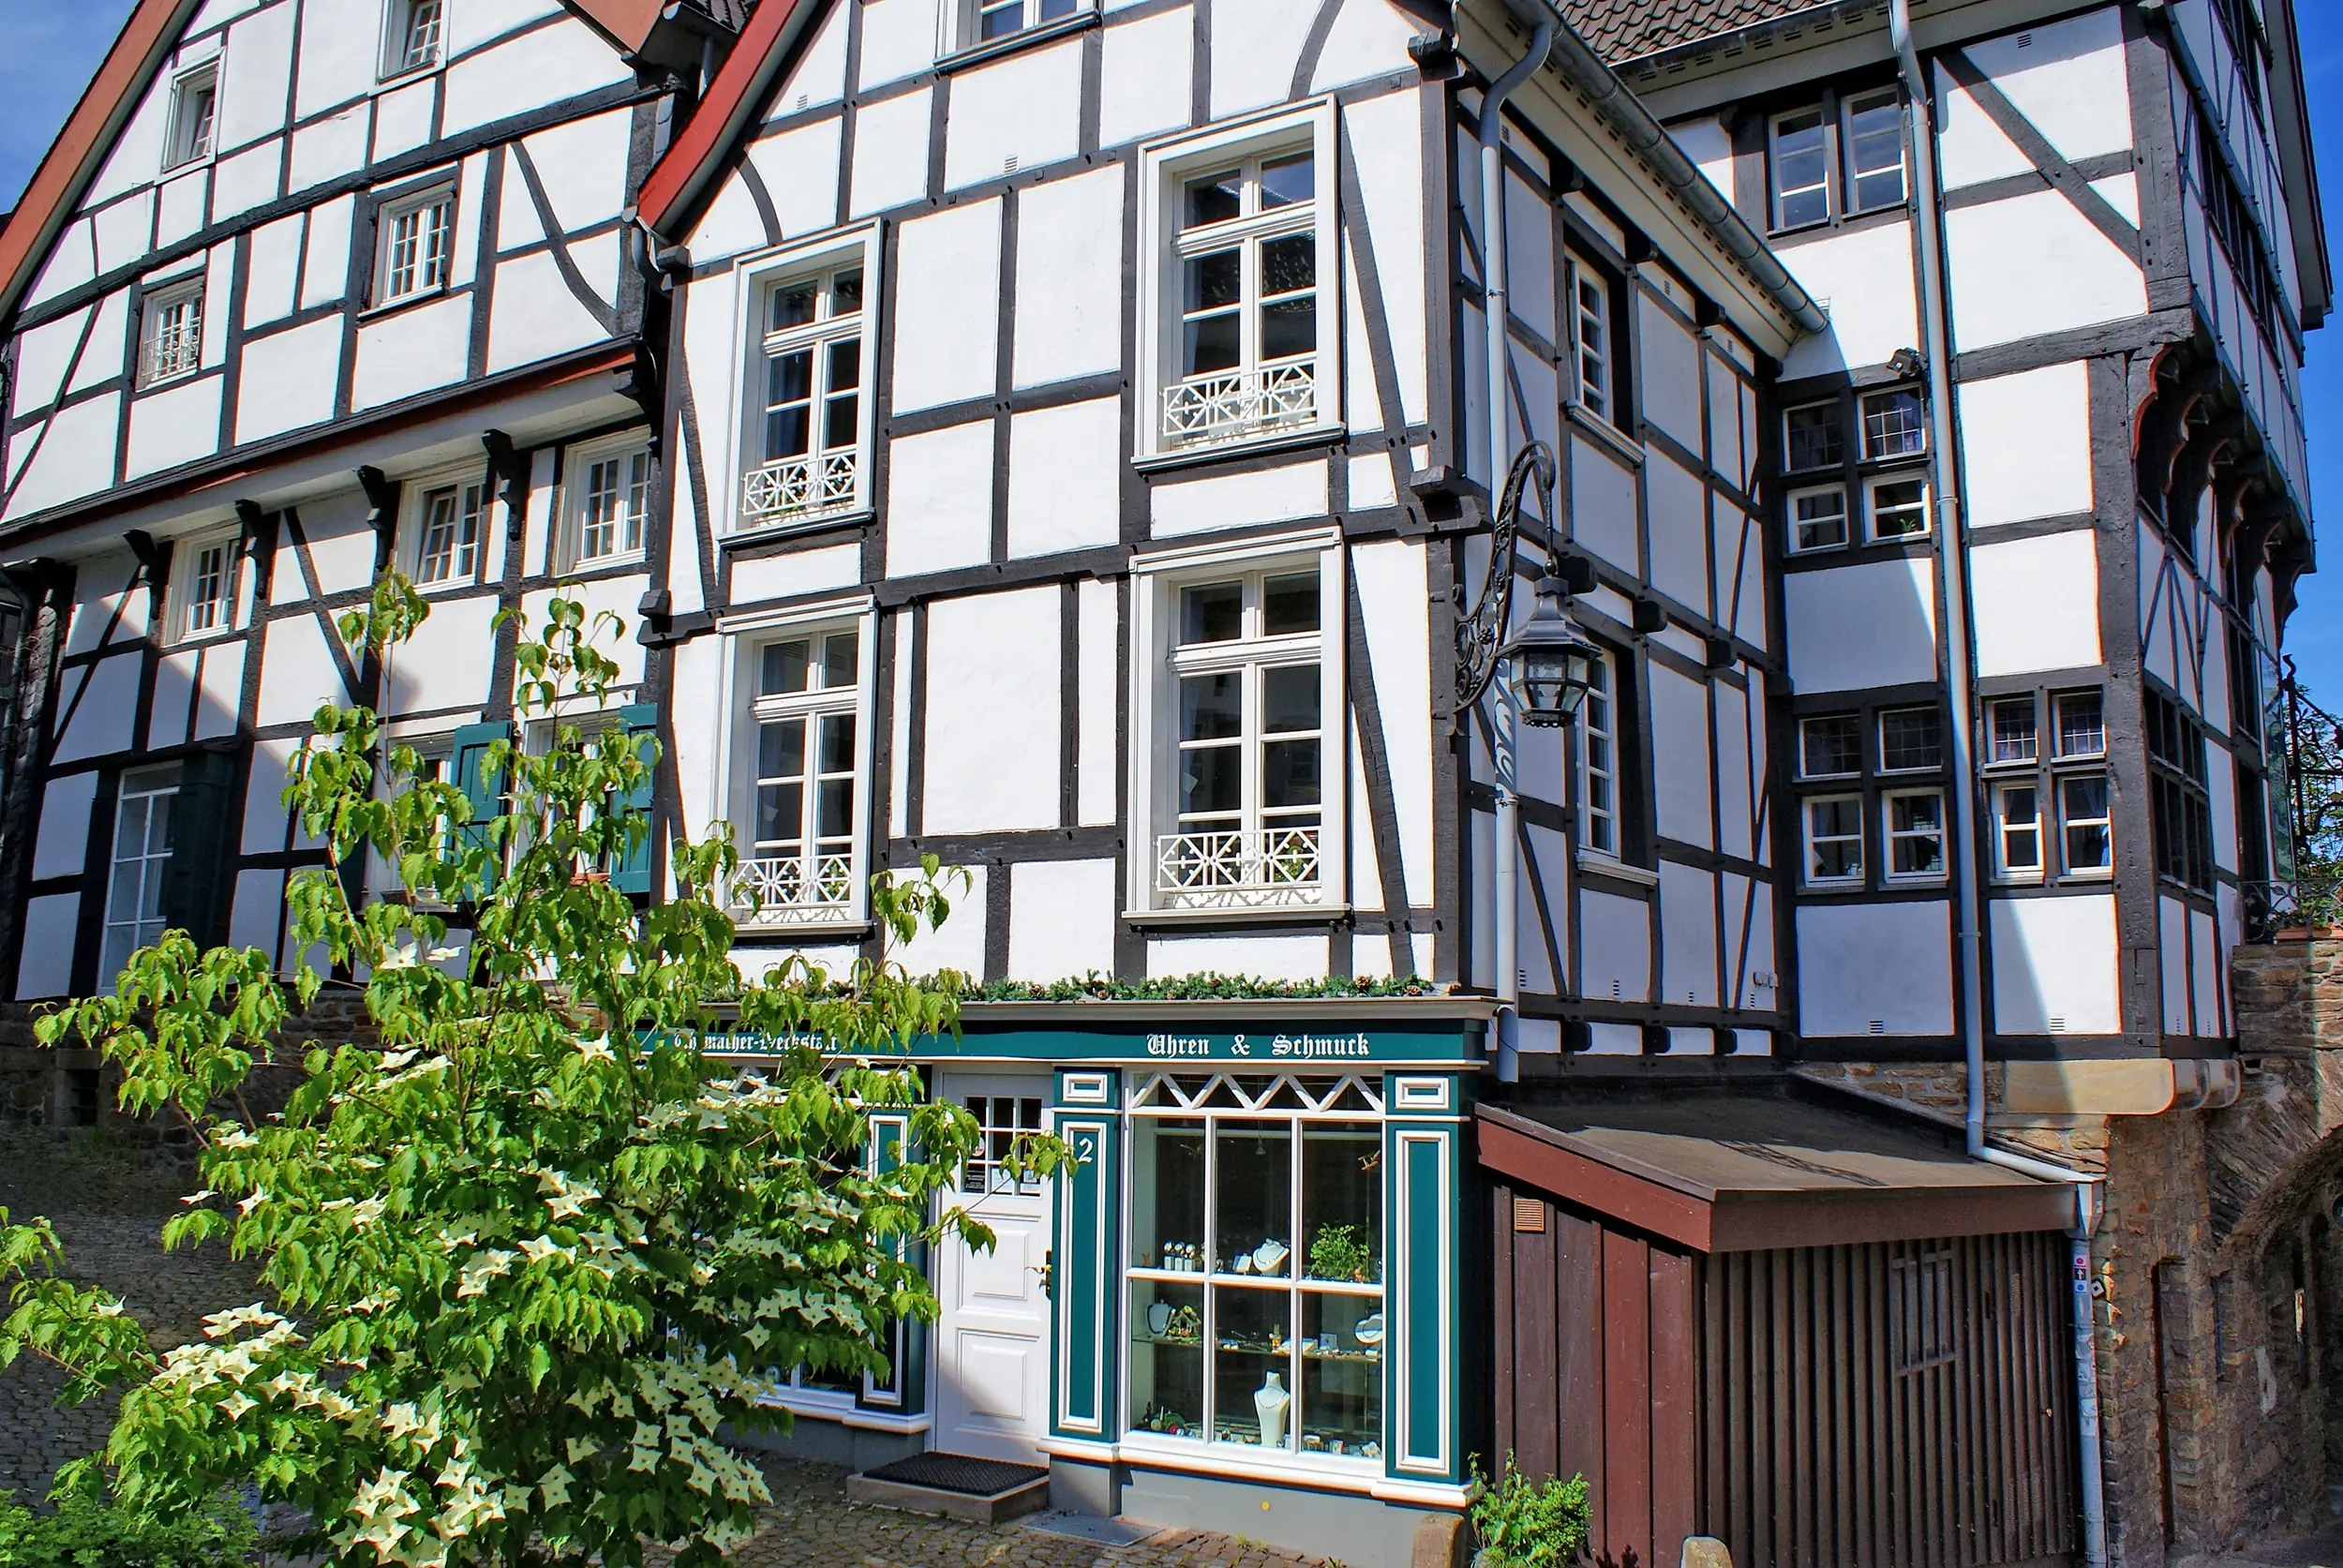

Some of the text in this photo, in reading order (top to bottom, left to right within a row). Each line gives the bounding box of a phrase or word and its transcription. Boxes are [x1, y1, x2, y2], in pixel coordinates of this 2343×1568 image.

[674, 1031, 837, 1053] hmacher-Werkstat
[1146, 1033, 1370, 1059] Uhren & Schmuck
[1079, 1137, 1093, 1163] 2
